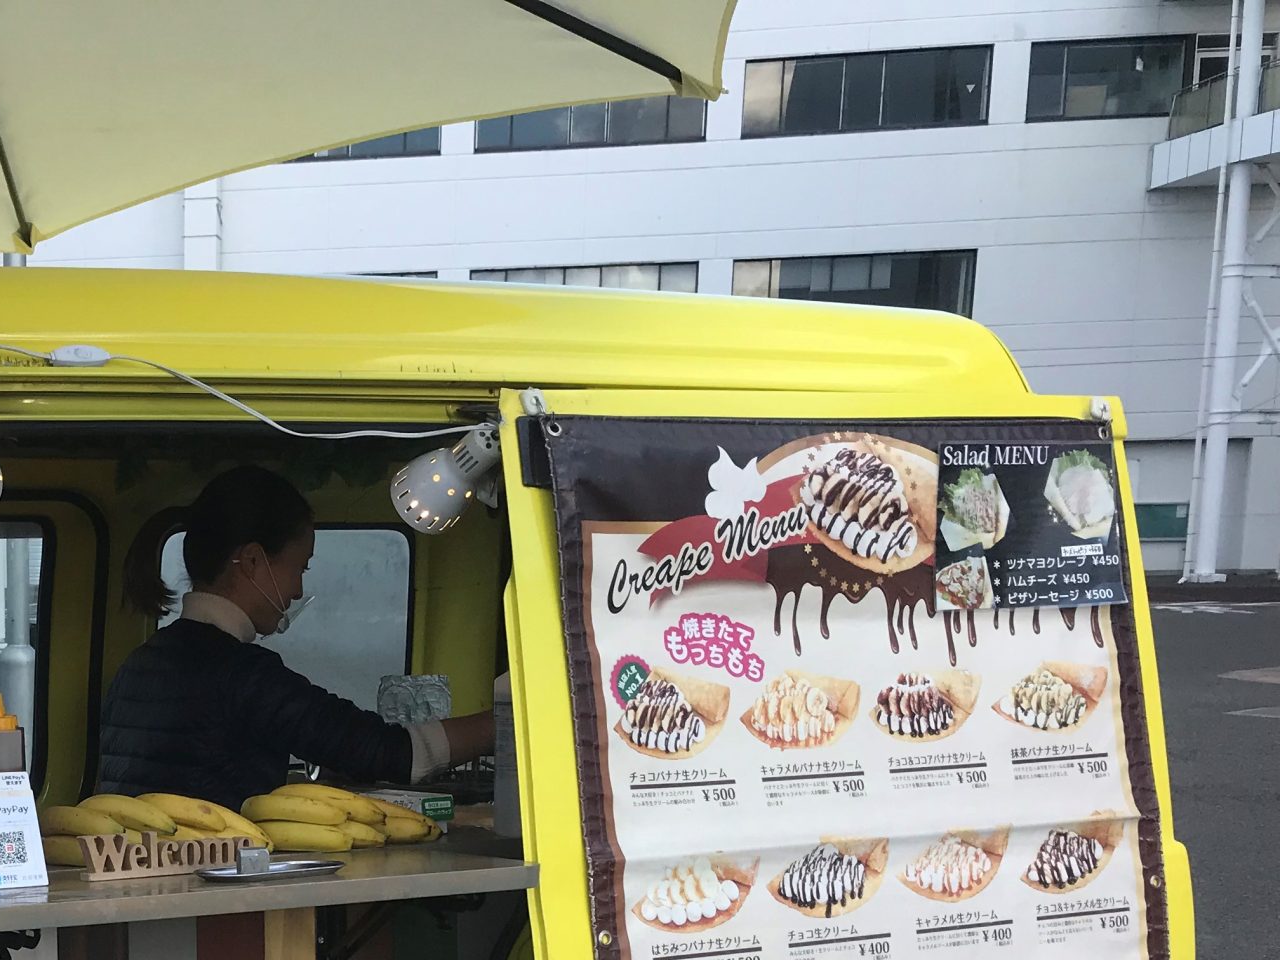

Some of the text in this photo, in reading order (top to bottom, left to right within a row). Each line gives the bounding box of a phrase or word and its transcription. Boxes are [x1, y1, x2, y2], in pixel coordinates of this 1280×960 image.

[942, 445, 1050, 467] Salad MENU
[607, 505, 807, 615] Creape Menu
[1092, 554, 1119, 566] ¥450
[1006, 573, 1090, 587] ハムチーズ ¥450
[1007, 588, 1114, 605] ピザソーセージ ¥500
[681, 616, 754, 648] 焼きたて
[666, 631, 765, 680] もっちもち
[1077, 760, 1108, 774] ¥500
[629, 767, 728, 784] チョコバナナ生クリーム
[956, 770, 987, 784] ¥500
[832, 778, 865, 793] ¥500
[701, 787, 737, 802] ¥500
[915, 909, 999, 927] キャラメル生クリーム
[1099, 914, 1130, 929] ¥500
[787, 924, 859, 942] チョコ生クリーム
[982, 927, 1013, 943] ¥400
[651, 935, 761, 956] はちみつバナナ生クリーム
[858, 940, 891, 956] ¥400
